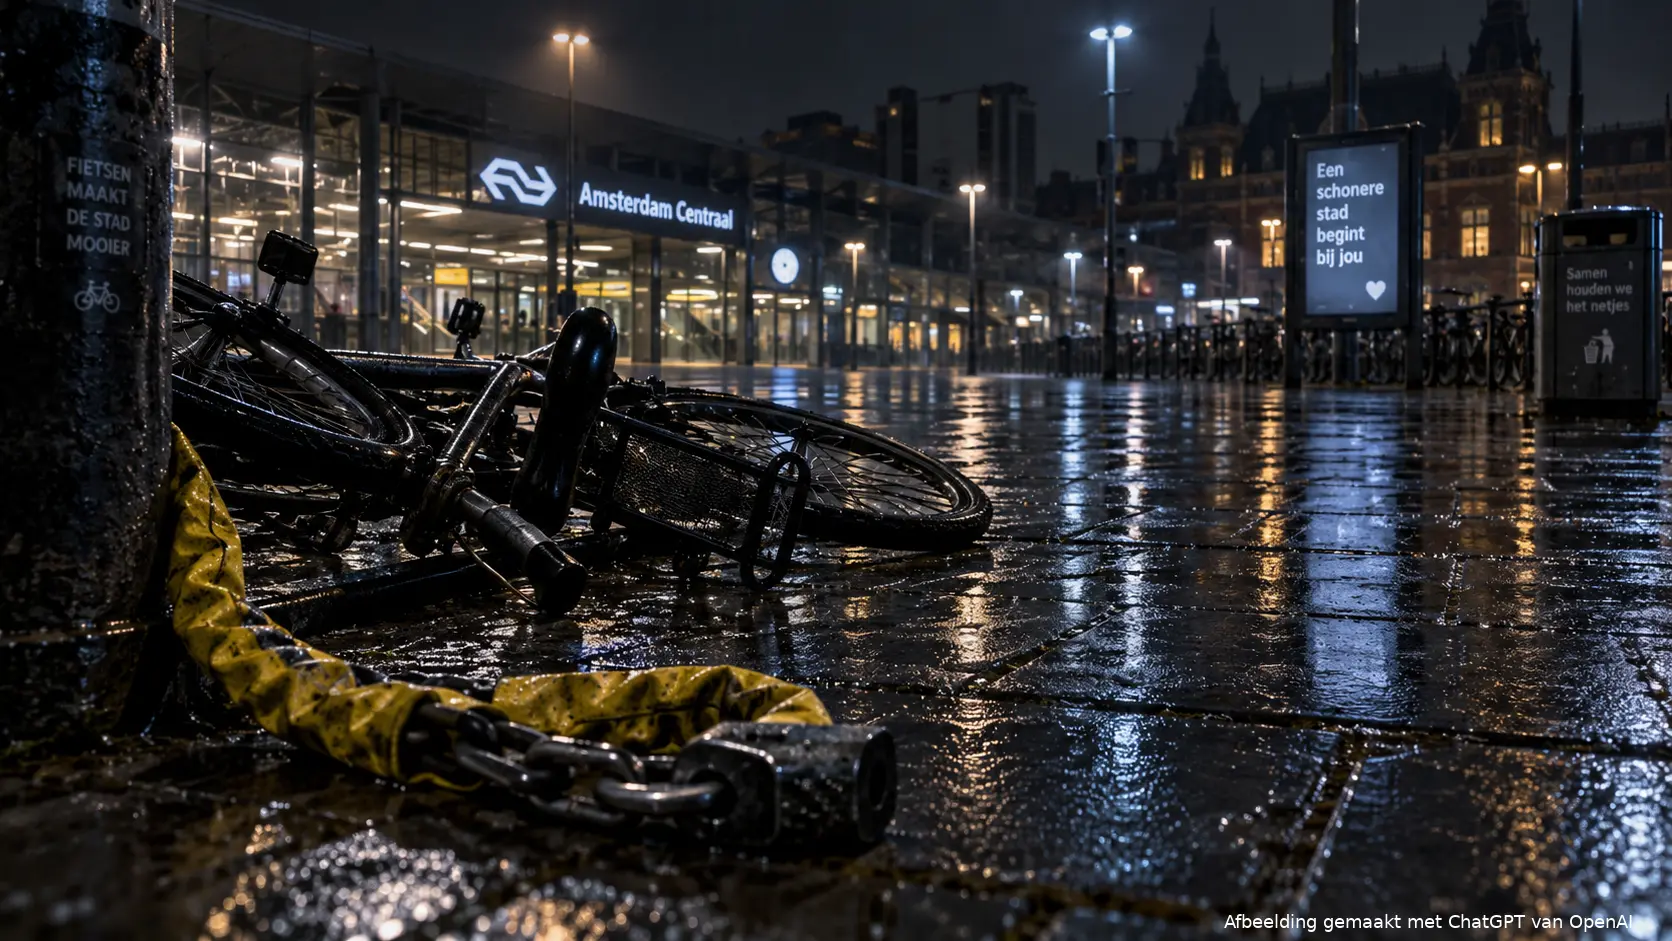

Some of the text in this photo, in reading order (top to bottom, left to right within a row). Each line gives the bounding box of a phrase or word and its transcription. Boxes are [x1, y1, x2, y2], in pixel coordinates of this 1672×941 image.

[67, 156, 132, 183] FIETSEN
[1316, 162, 1344, 179] Een
[66, 180, 129, 206] MAAKT
[1316, 182, 1385, 200] schonere
[579, 181, 734, 231] Amsterdam Centraal
[1316, 203, 1349, 222] stad
[66, 208, 131, 232] DE STAD
[66, 233, 131, 257] MOOIER
[1316, 225, 1366, 246] begint
[1316, 248, 1364, 268] bij jou
[1566, 266, 1608, 280] Samen
[1566, 282, 1633, 297] houden we
[1566, 298, 1630, 315] het netjes
